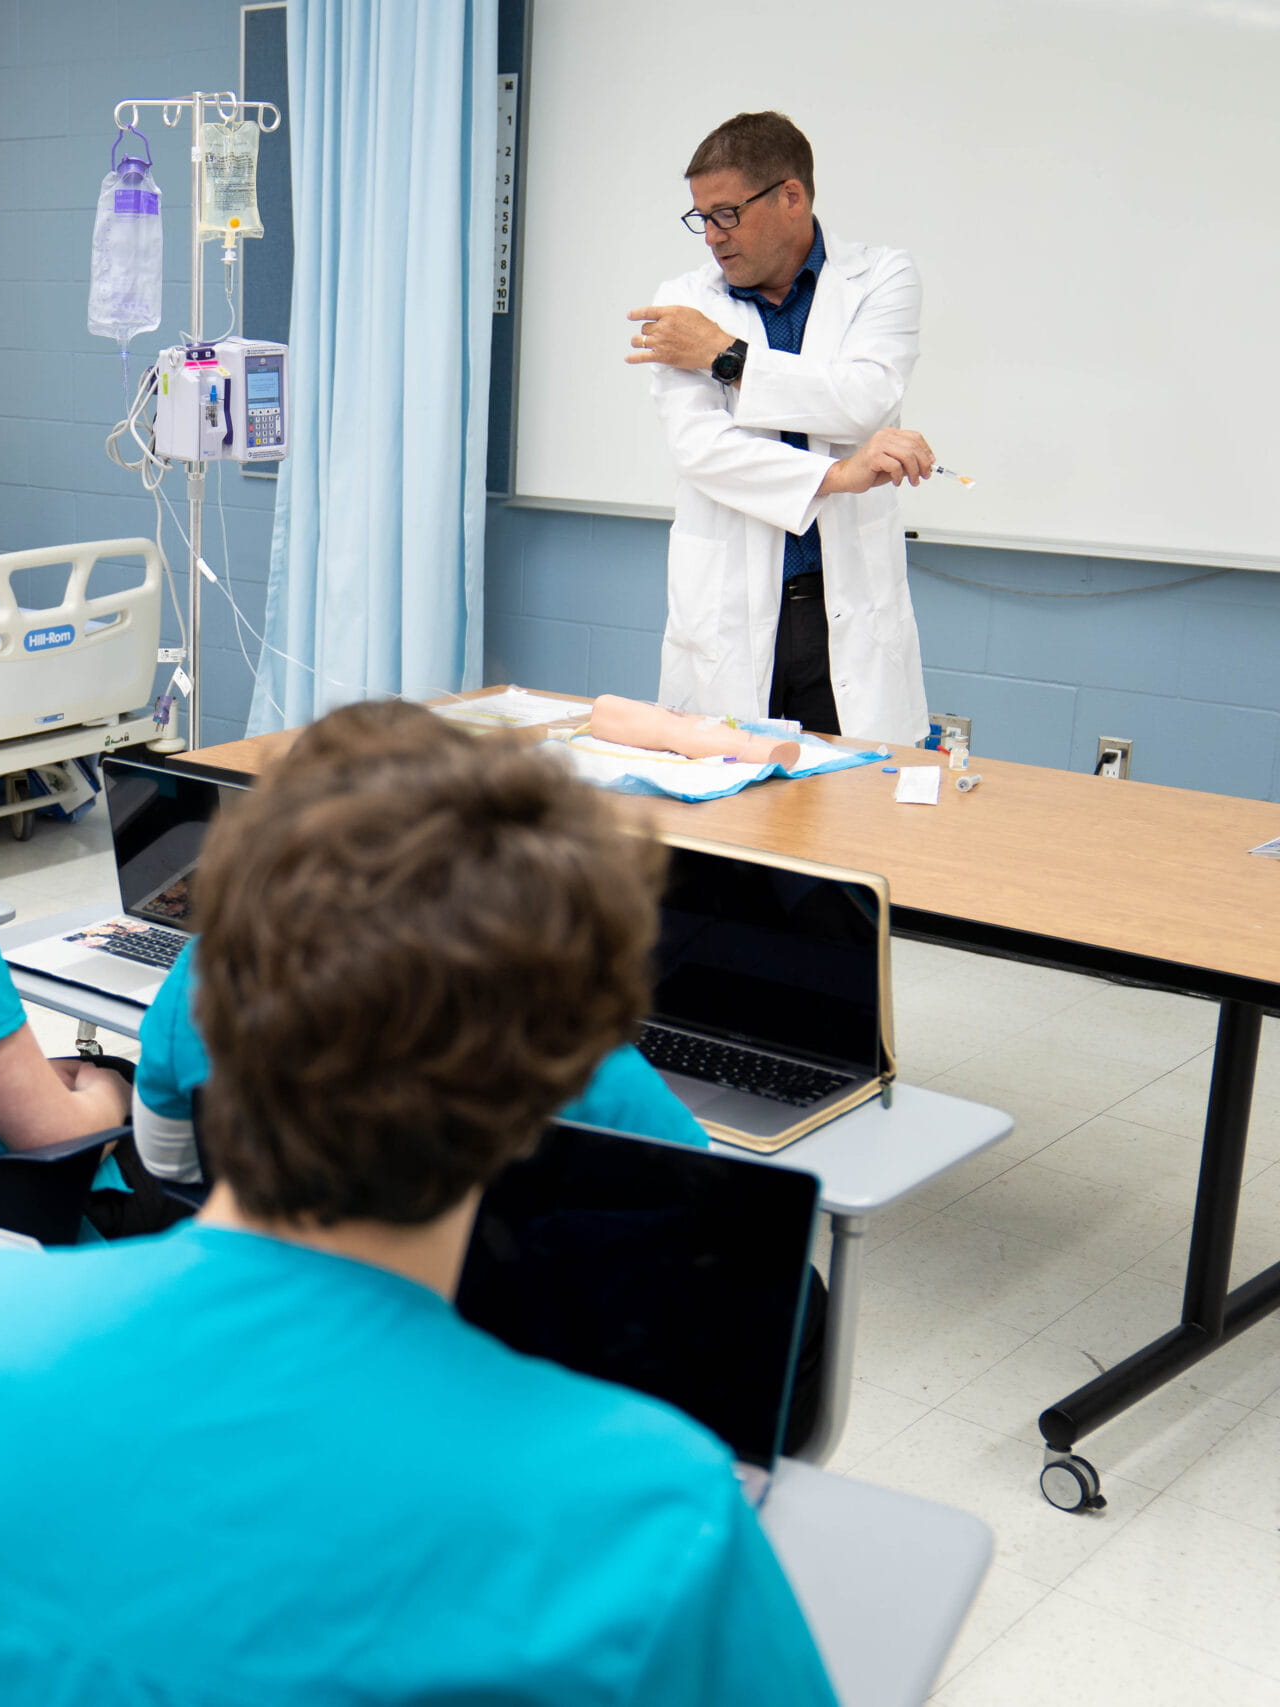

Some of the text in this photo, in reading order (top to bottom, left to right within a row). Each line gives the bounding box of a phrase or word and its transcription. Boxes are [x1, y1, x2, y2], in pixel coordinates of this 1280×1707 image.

[507, 115, 512, 125] 1
[505, 146, 511, 156] 2
[504, 174, 510, 185] 3
[503, 195, 509, 205] 4
[503, 211, 509, 221] 5
[502, 224, 508, 234] 6
[501, 244, 508, 254] 7
[500, 259, 507, 270] 8
[500, 276, 506, 286] 9
[497, 288, 507, 298] 10
[496, 300, 506, 311] 11
[29, 631, 71, 647] Hill-Rom
